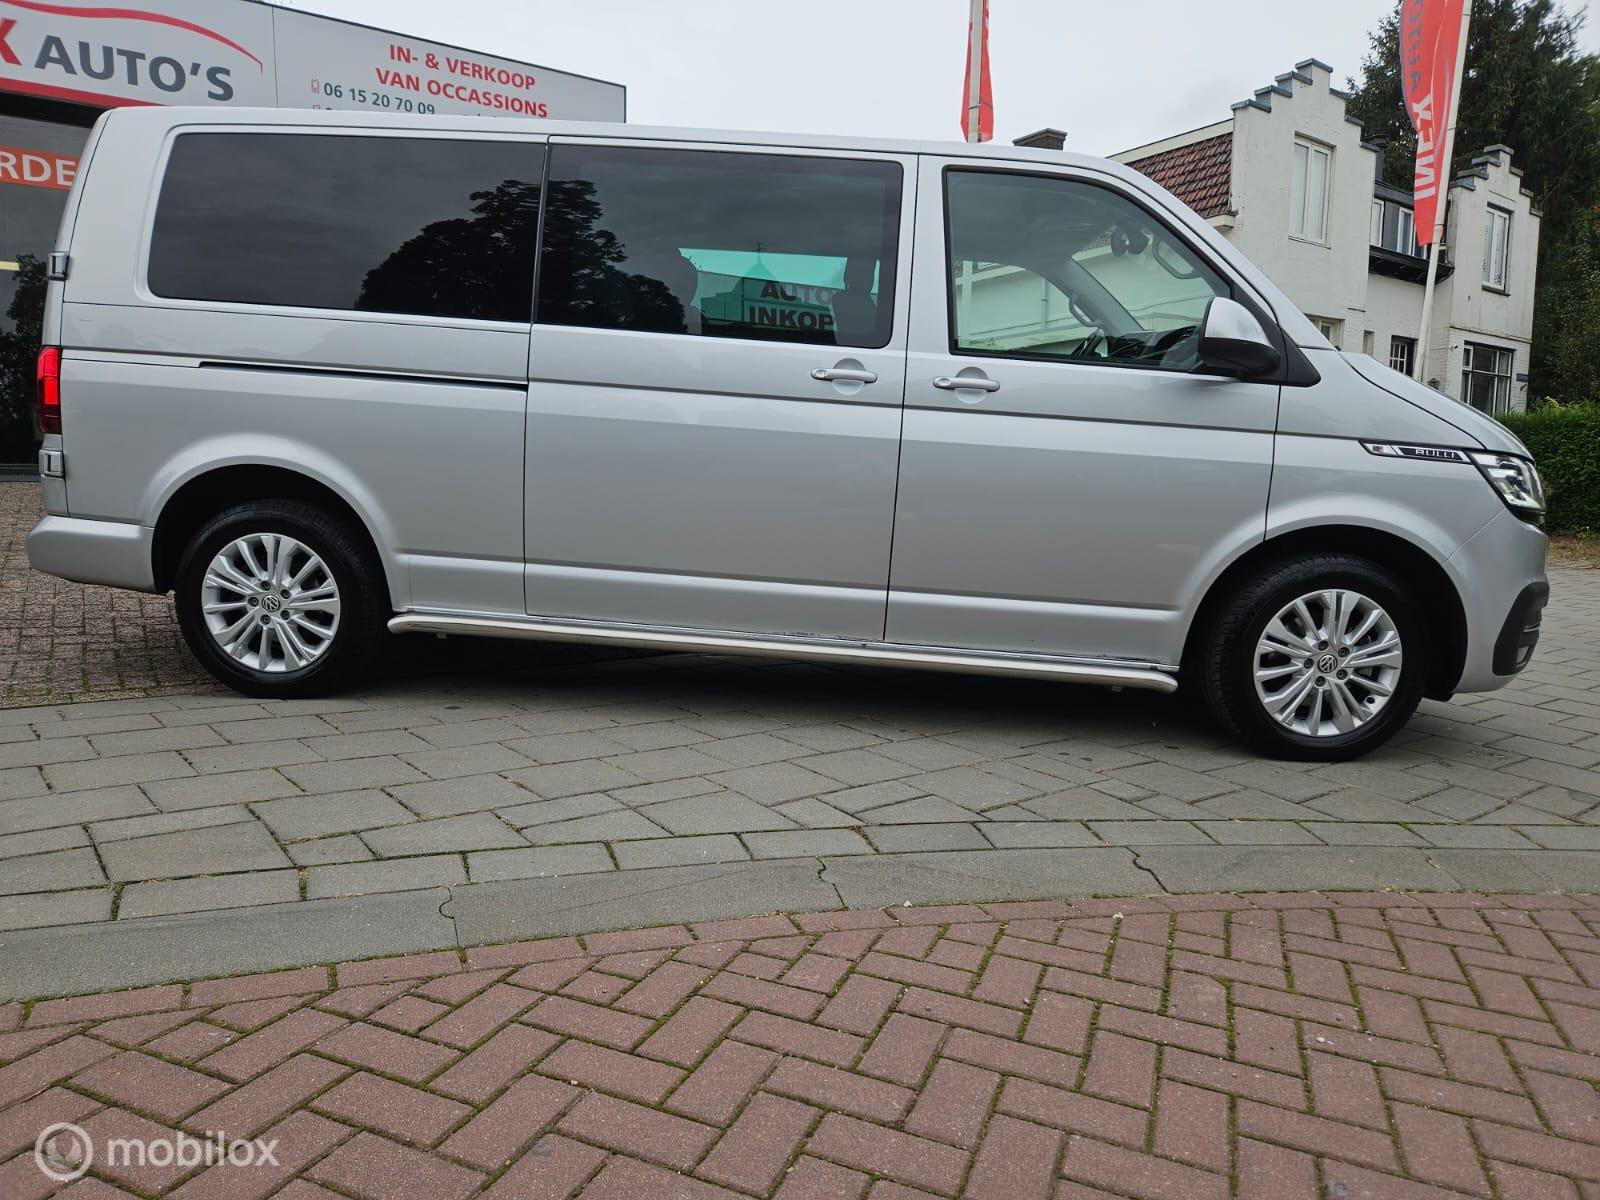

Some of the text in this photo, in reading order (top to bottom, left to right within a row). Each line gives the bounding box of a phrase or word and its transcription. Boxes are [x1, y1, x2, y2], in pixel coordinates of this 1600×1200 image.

[34, 34, 234, 102] AUTO'S
[390, 44, 536, 90] IN- & VERKOOP
[323, 82, 435, 115] 06 15 20 70 09
[375, 67, 548, 118] VAN OCCASSIONS
